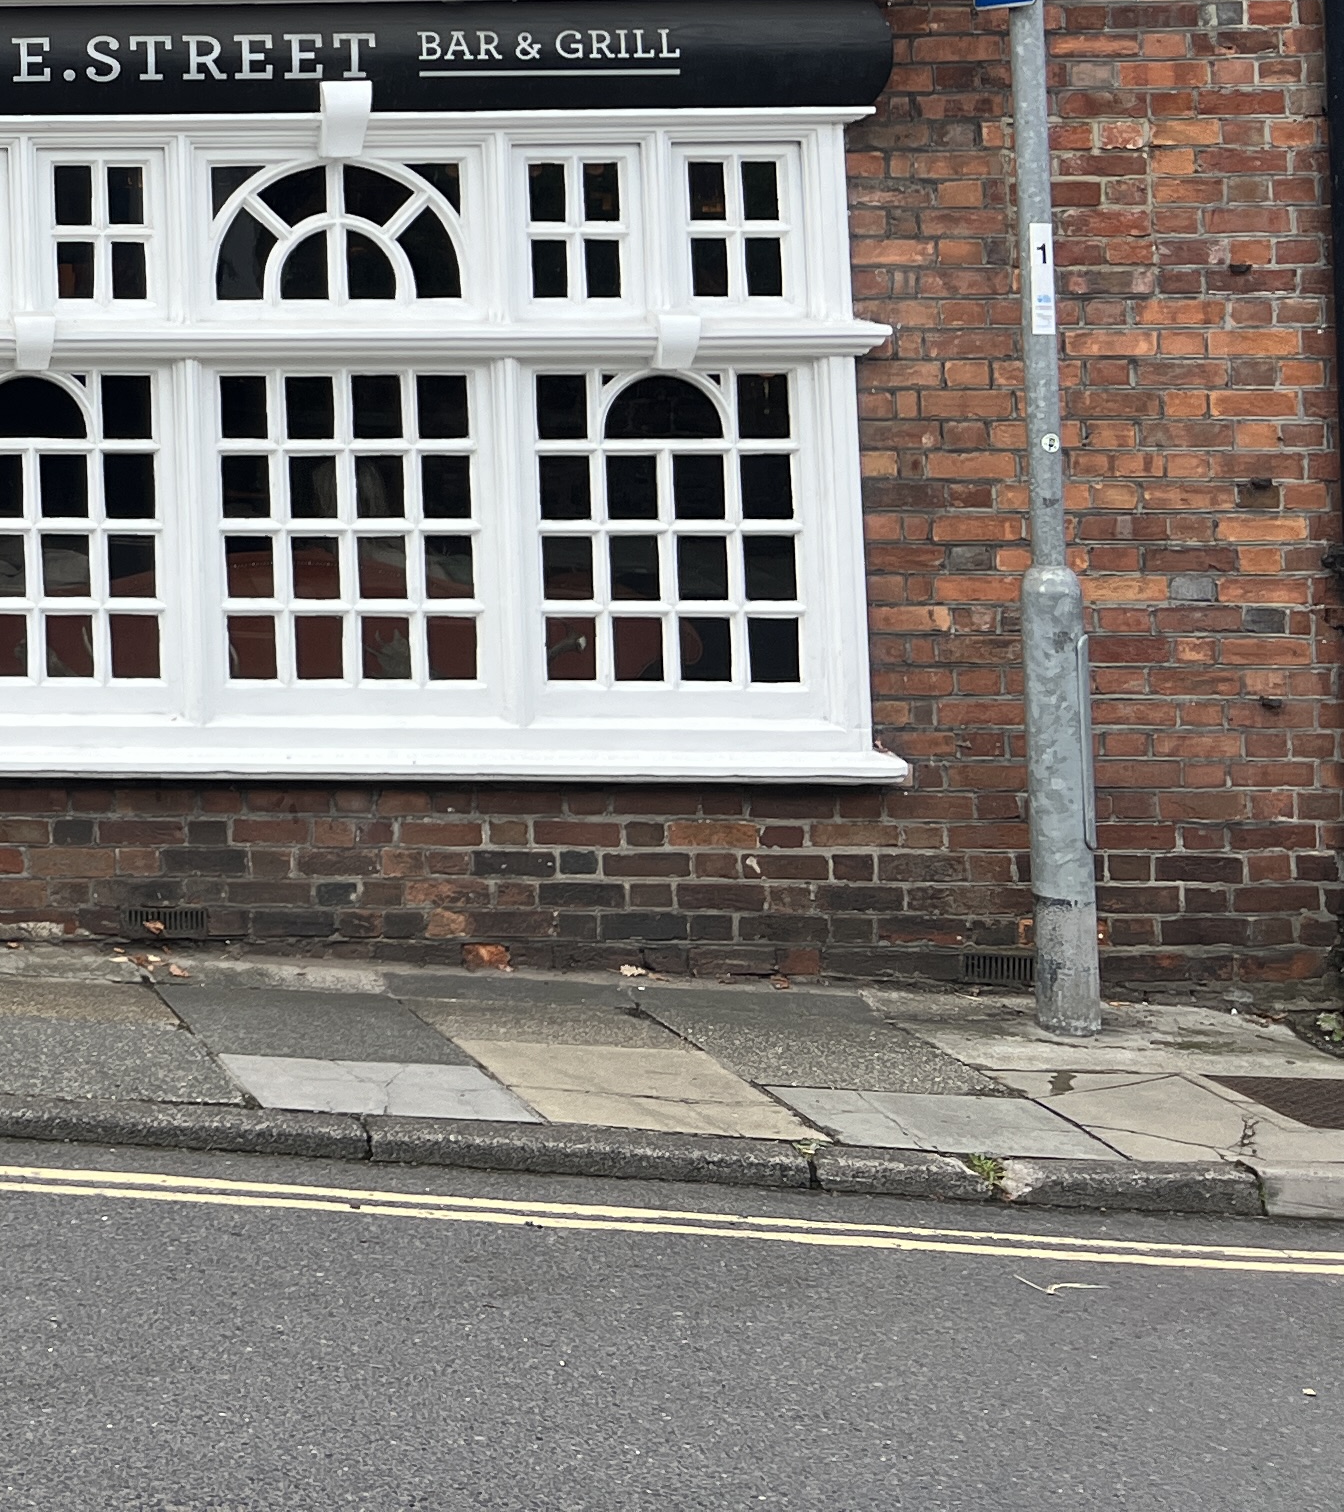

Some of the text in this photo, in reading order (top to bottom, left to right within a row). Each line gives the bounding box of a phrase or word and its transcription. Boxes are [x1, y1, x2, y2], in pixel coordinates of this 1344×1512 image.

[11, 33, 377, 82] E.STREET
[417, 29, 681, 61] BAR & GRILL
[1036, 243, 1047, 264] 1
